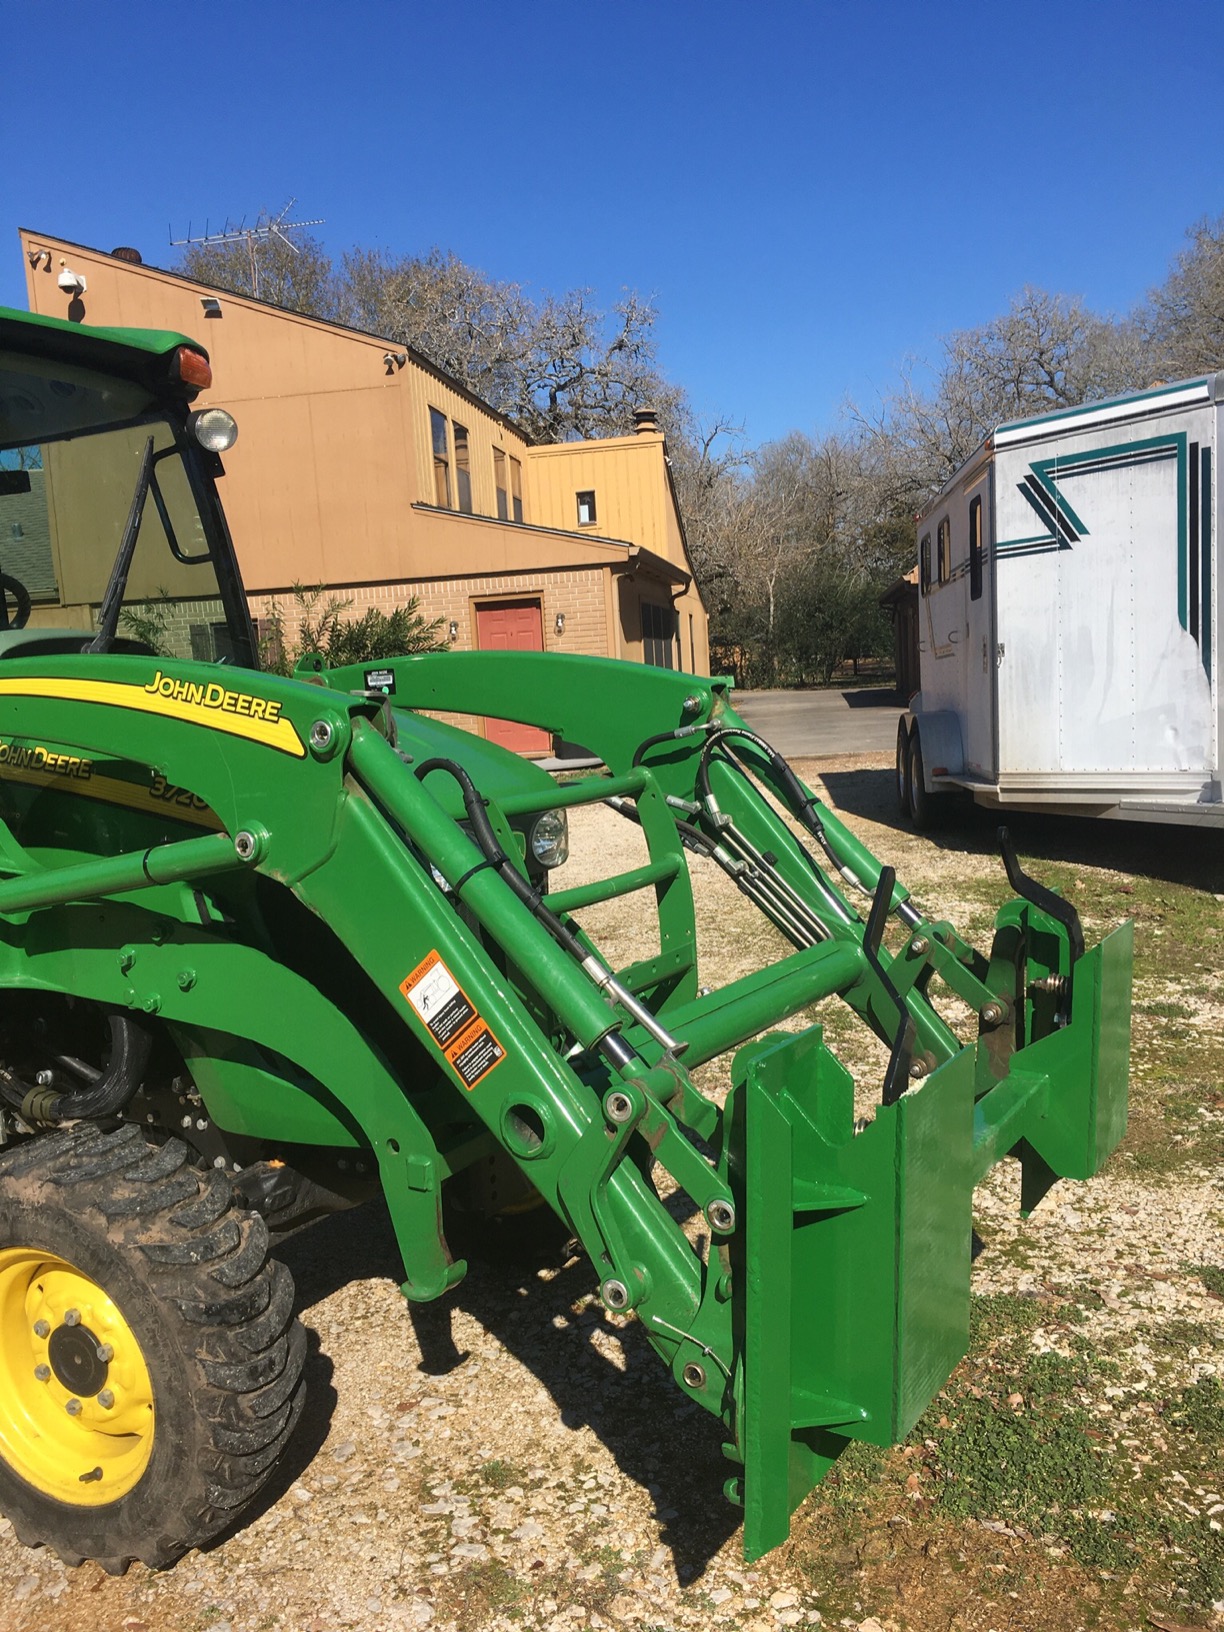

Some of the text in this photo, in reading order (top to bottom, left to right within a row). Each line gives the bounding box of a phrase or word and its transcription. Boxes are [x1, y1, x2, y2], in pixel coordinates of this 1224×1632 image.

[144, 671, 282, 723] JOHN DEERE
[31, 746, 93, 779] DEERE
[411, 957, 435, 984] WARNING
[457, 1024, 483, 1051] WARNING
